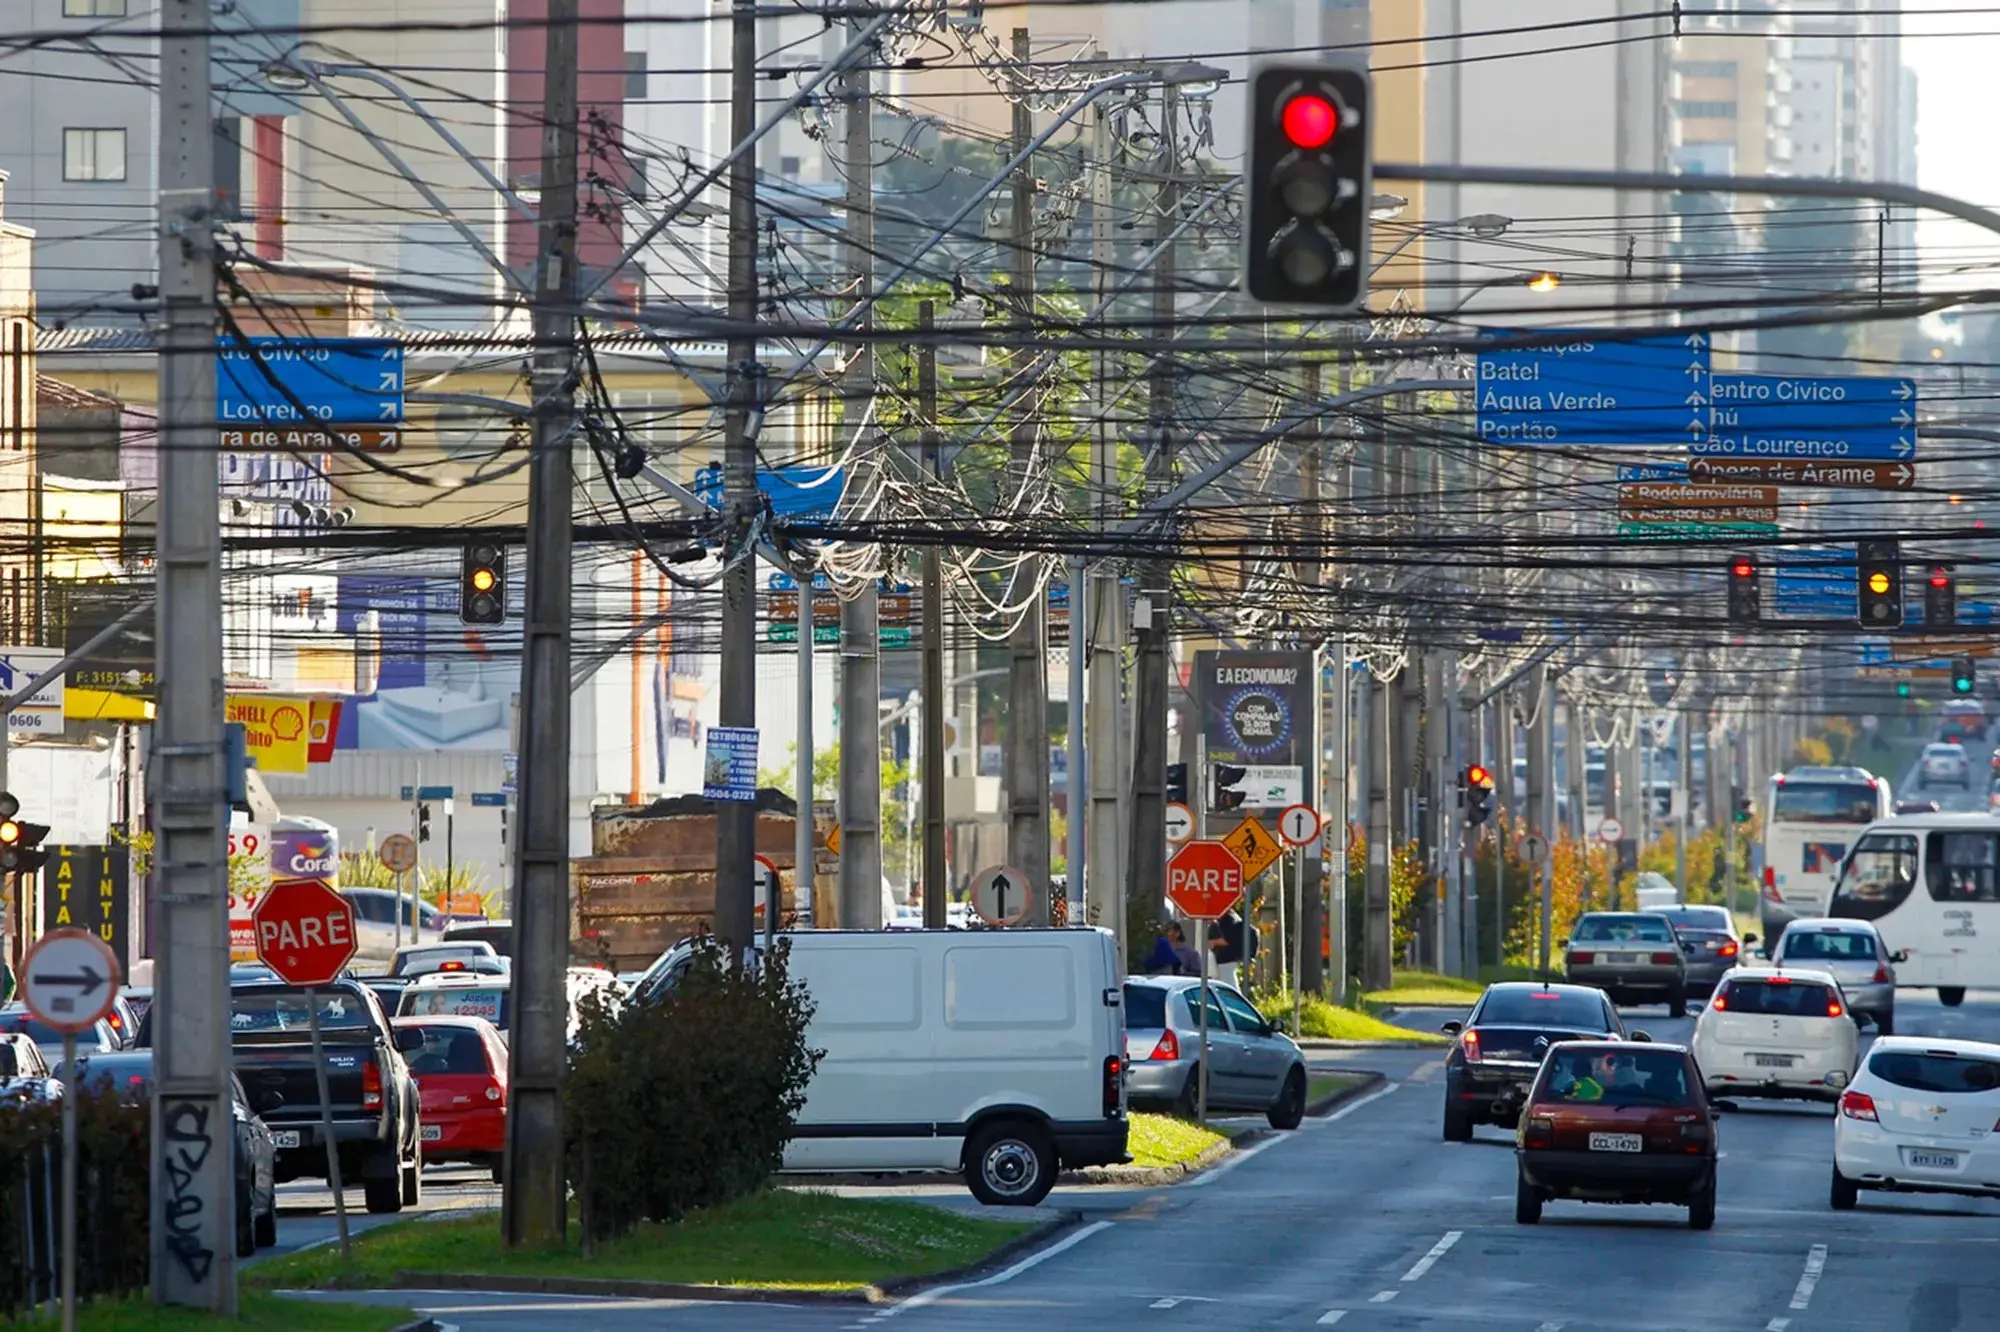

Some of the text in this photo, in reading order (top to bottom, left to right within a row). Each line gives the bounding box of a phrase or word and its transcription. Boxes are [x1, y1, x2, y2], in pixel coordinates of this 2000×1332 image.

[1481, 361, 1540, 381] Batel
[1482, 386, 1617, 415] Água Verde
[1776, 381, 1846, 401] Cívico
[250, 429, 279, 447] de
[1482, 420, 1557, 440] Portão
[1802, 463, 1876, 483] Arame
[1235, 668, 1298, 685] ECONOMIA?
[9, 714, 42, 727] 0606
[227, 705, 267, 723] SHELL
[1171, 868, 1239, 893] PARE
[100, 845, 114, 941] INTU
[260, 910, 349, 951] PARE
[454, 1003, 497, 1016] 12345
